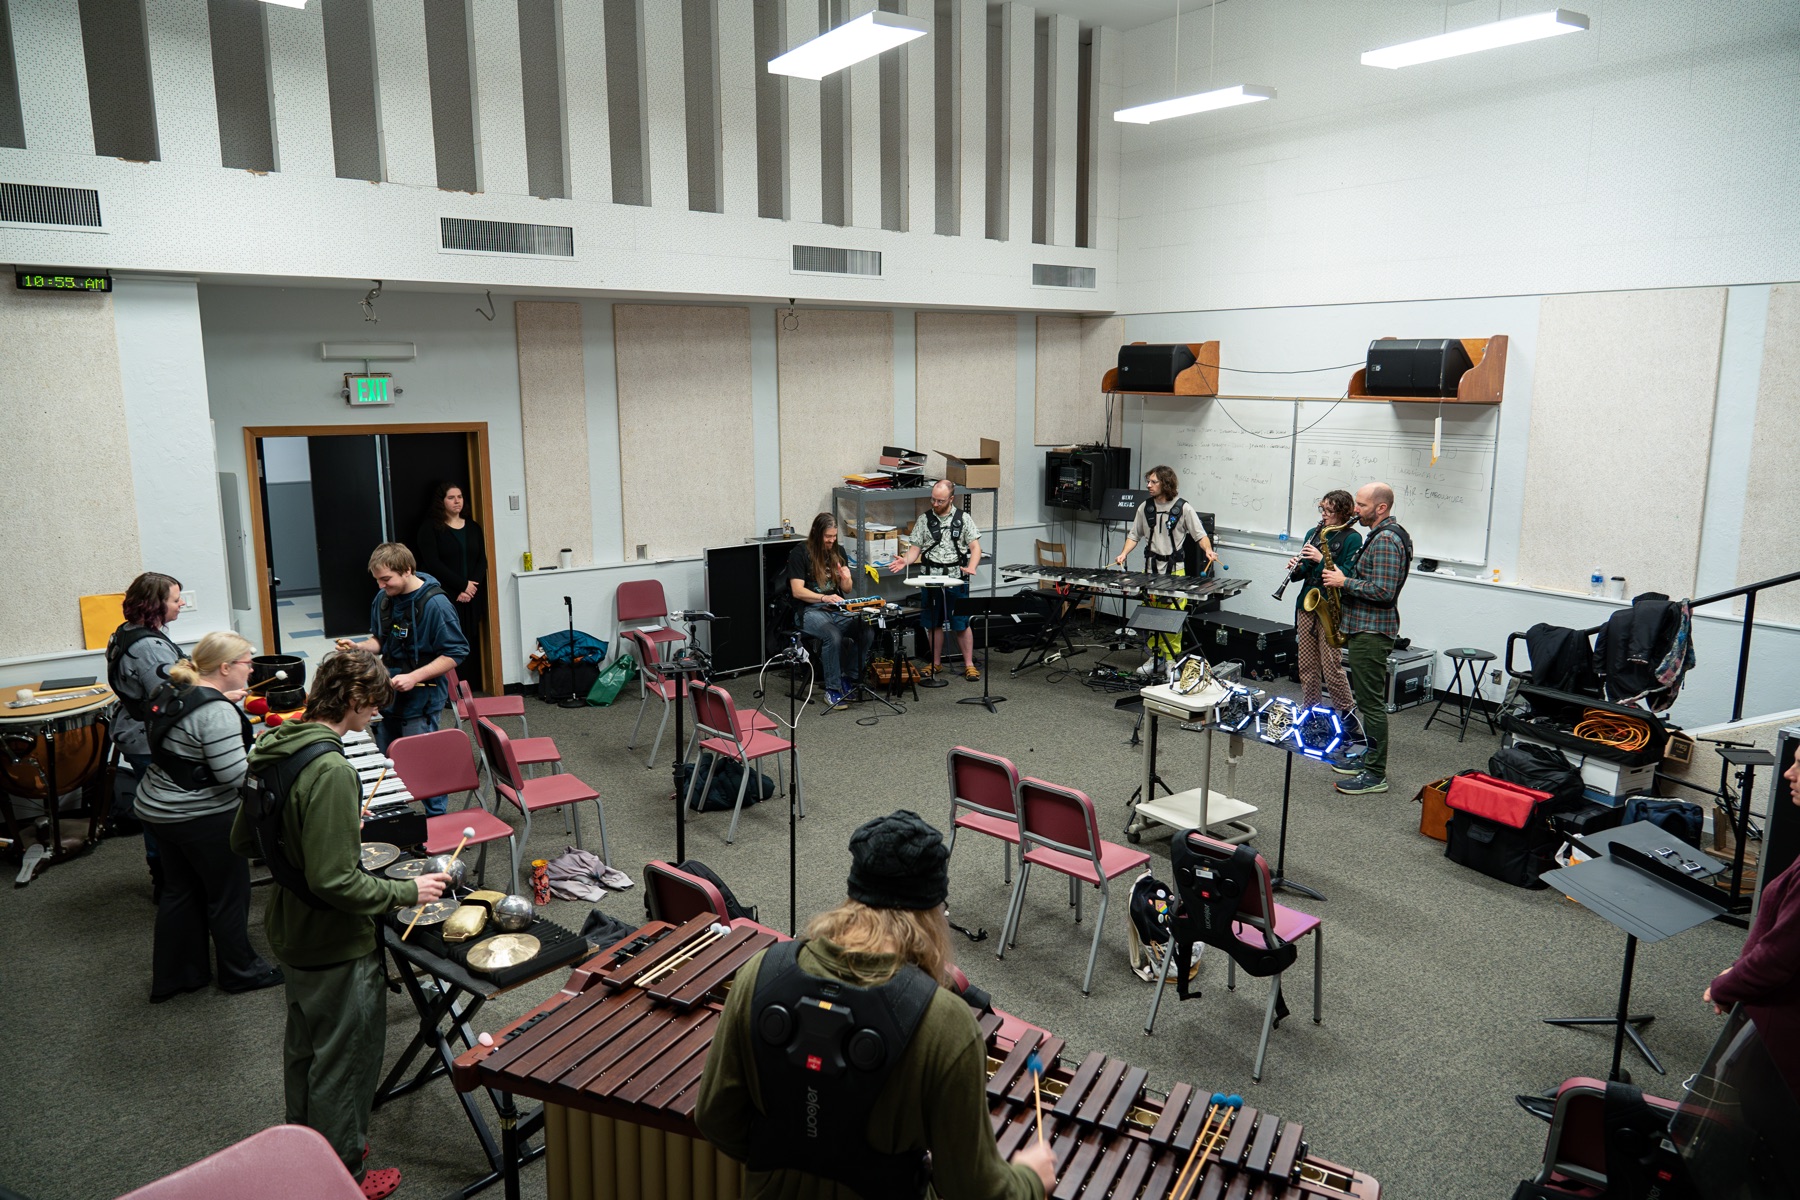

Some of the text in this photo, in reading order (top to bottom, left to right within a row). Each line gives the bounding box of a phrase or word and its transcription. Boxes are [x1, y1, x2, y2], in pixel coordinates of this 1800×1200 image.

[25, 275, 105, 290] 10:55 AM
[357, 378, 389, 402] EXIT
[806, 1086, 820, 1137] woojer
